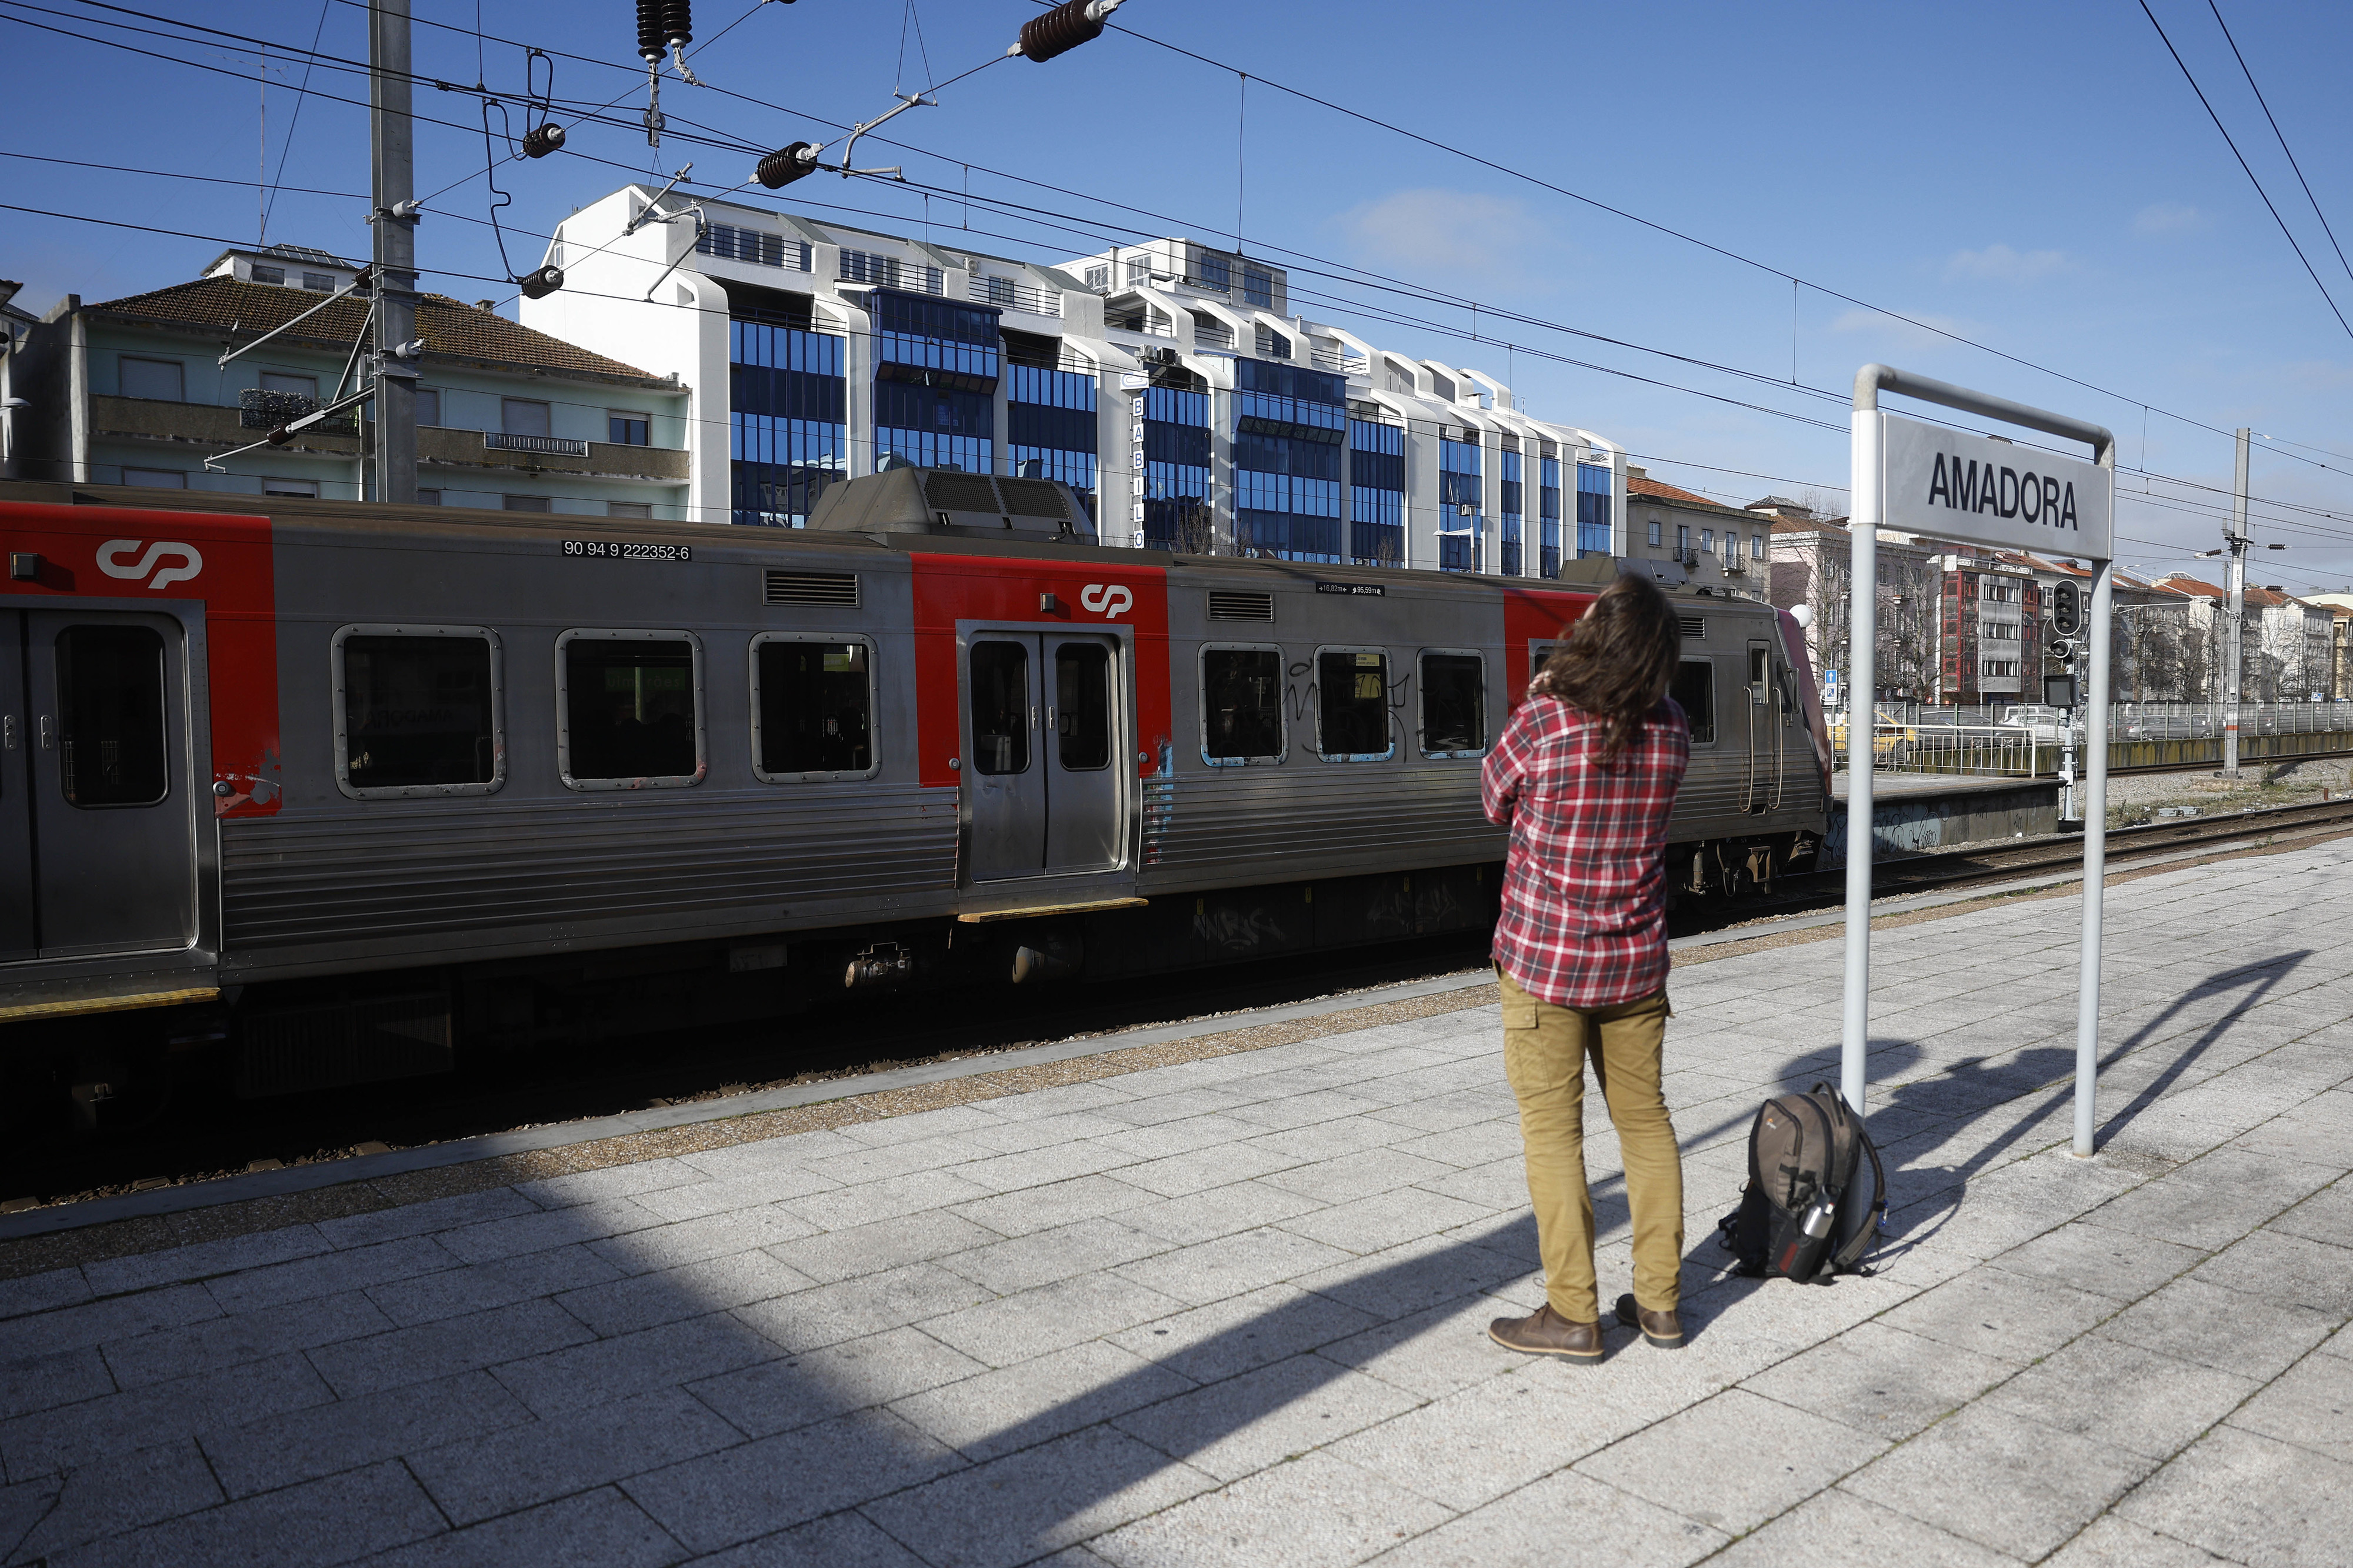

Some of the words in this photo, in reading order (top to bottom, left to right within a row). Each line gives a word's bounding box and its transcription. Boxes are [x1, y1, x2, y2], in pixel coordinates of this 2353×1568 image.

[1135, 398, 1143, 547] BABILO
[1928, 452, 2078, 531] AMADORA
[96, 539, 203, 589] CP
[565, 541, 583, 555] 90
[587, 542, 605, 556] 94
[610, 543, 619, 556] 9
[624, 544, 689, 560] 222352-6
[1081, 584, 1133, 618] CP
[1324, 585, 1343, 593] 16,82m
[1357, 586, 1377, 595] 95,59m
